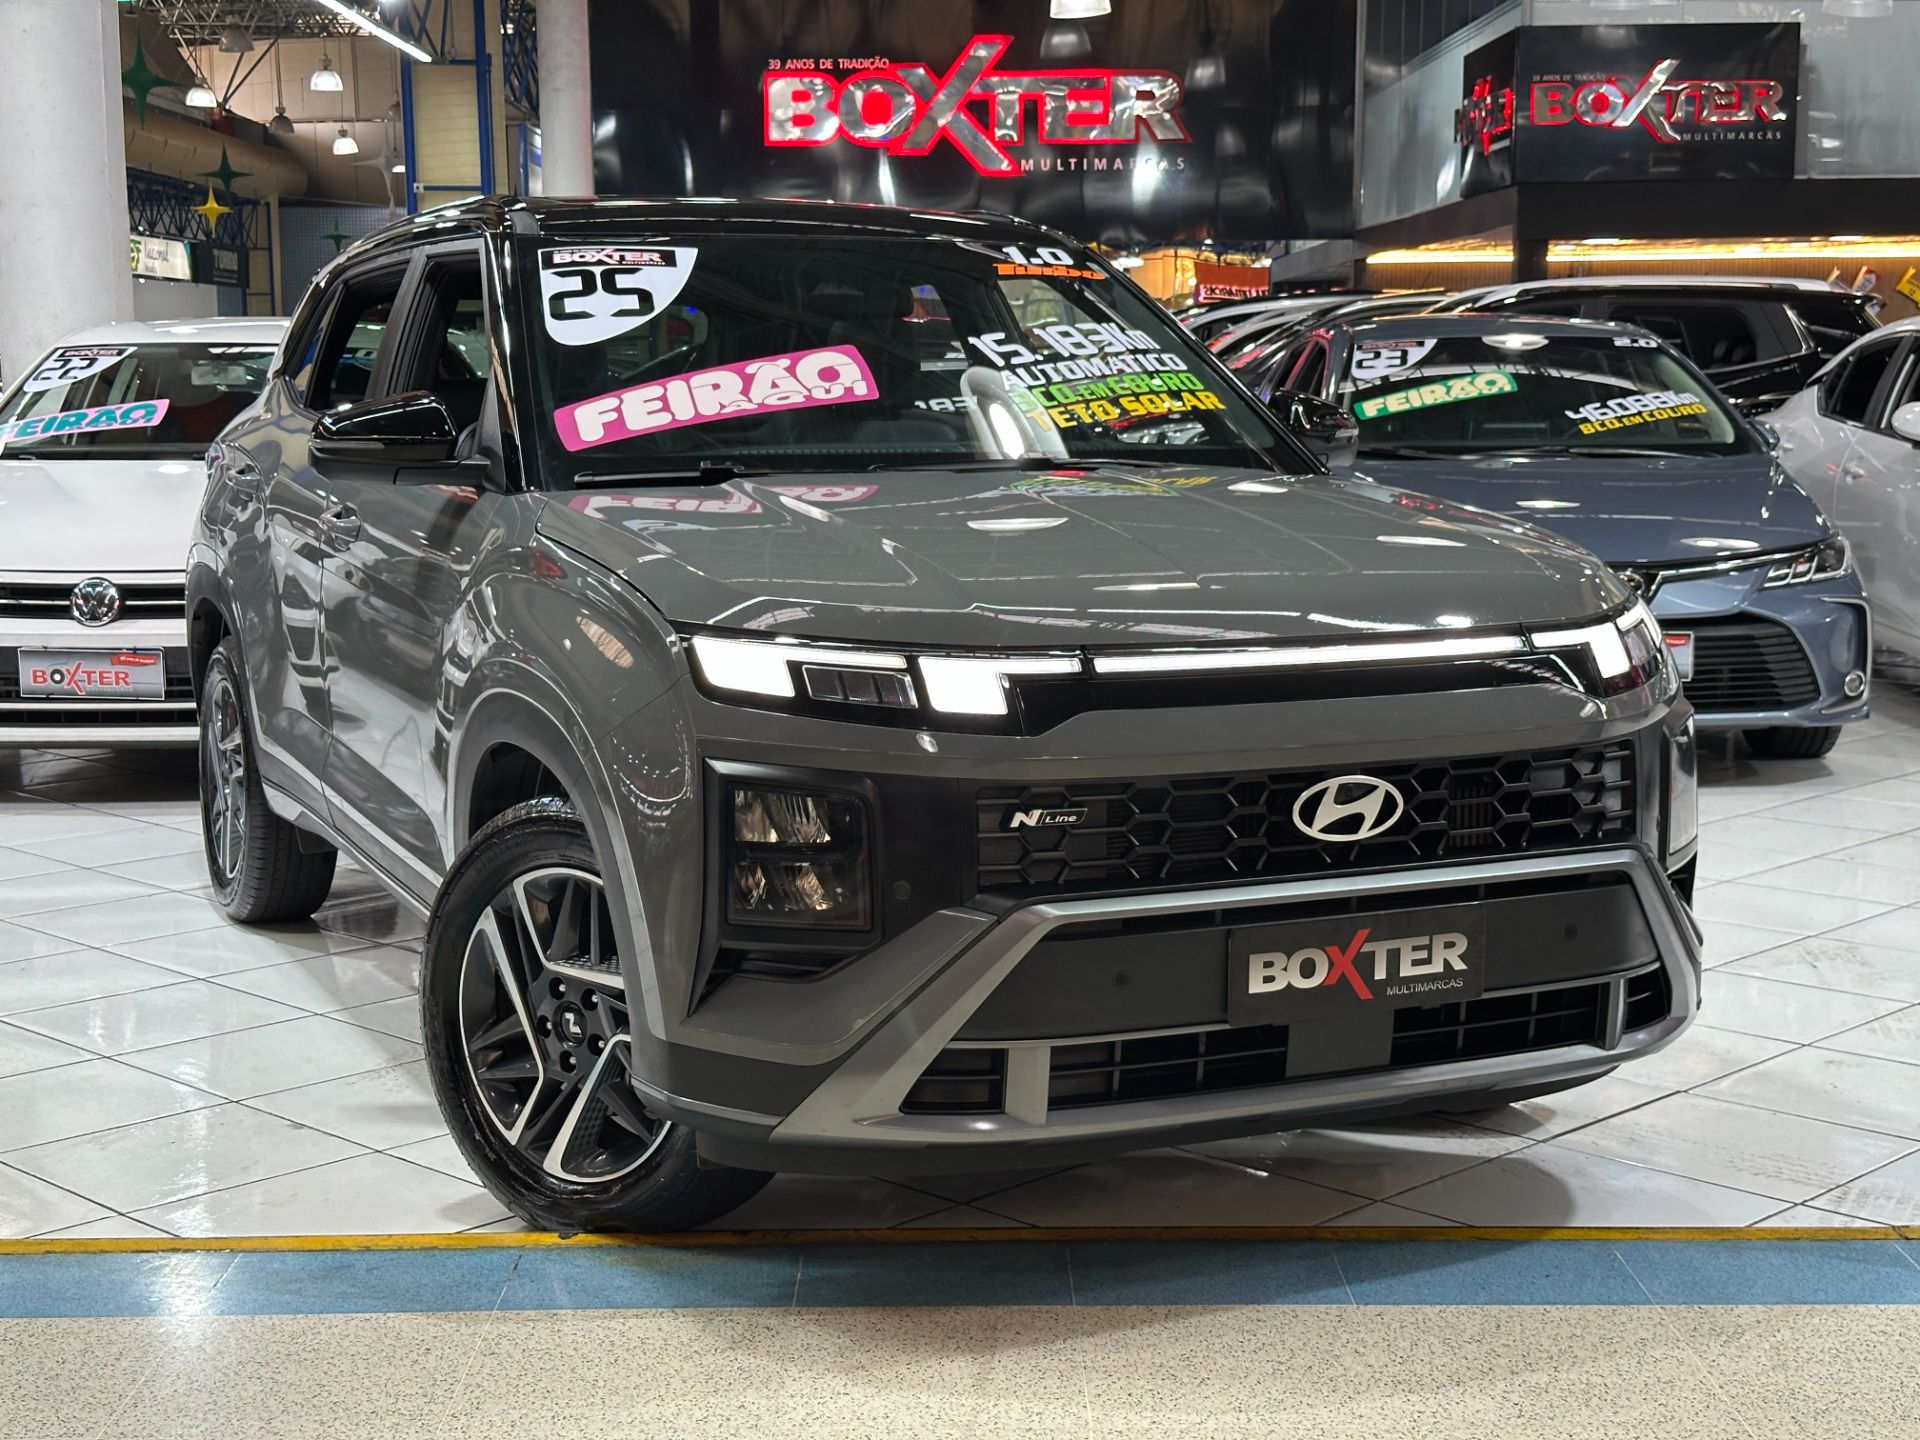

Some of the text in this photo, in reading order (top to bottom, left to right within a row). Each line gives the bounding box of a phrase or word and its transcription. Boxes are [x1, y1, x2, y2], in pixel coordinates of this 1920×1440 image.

[768, 56, 889, 70] 39 ANOS DE TRADIÇÃO
[763, 34, 1193, 178] BOXTER
[1530, 58, 1787, 143] BOXTER
[1682, 131, 1782, 141] MULTIMARCAS
[552, 247, 662, 265] BOXTER
[1002, 246, 1074, 265] 1.0
[548, 267, 656, 321] 25
[1612, 336, 1658, 348] 2.0
[32, 357, 99, 382] 22
[1355, 348, 1409, 369] 23
[573, 351, 863, 442] FEIRÃO
[1362, 372, 1513, 417] FEIRÃO
[1025, 391, 1227, 432] TETO SOLAR
[1643, 403, 1708, 421] COURO
[30, 661, 132, 695] BOXTER
[1009, 808, 1078, 828] N Line
[1248, 927, 1469, 1000] BOXTER
[1386, 978, 1464, 996] MULTIMARCAS
